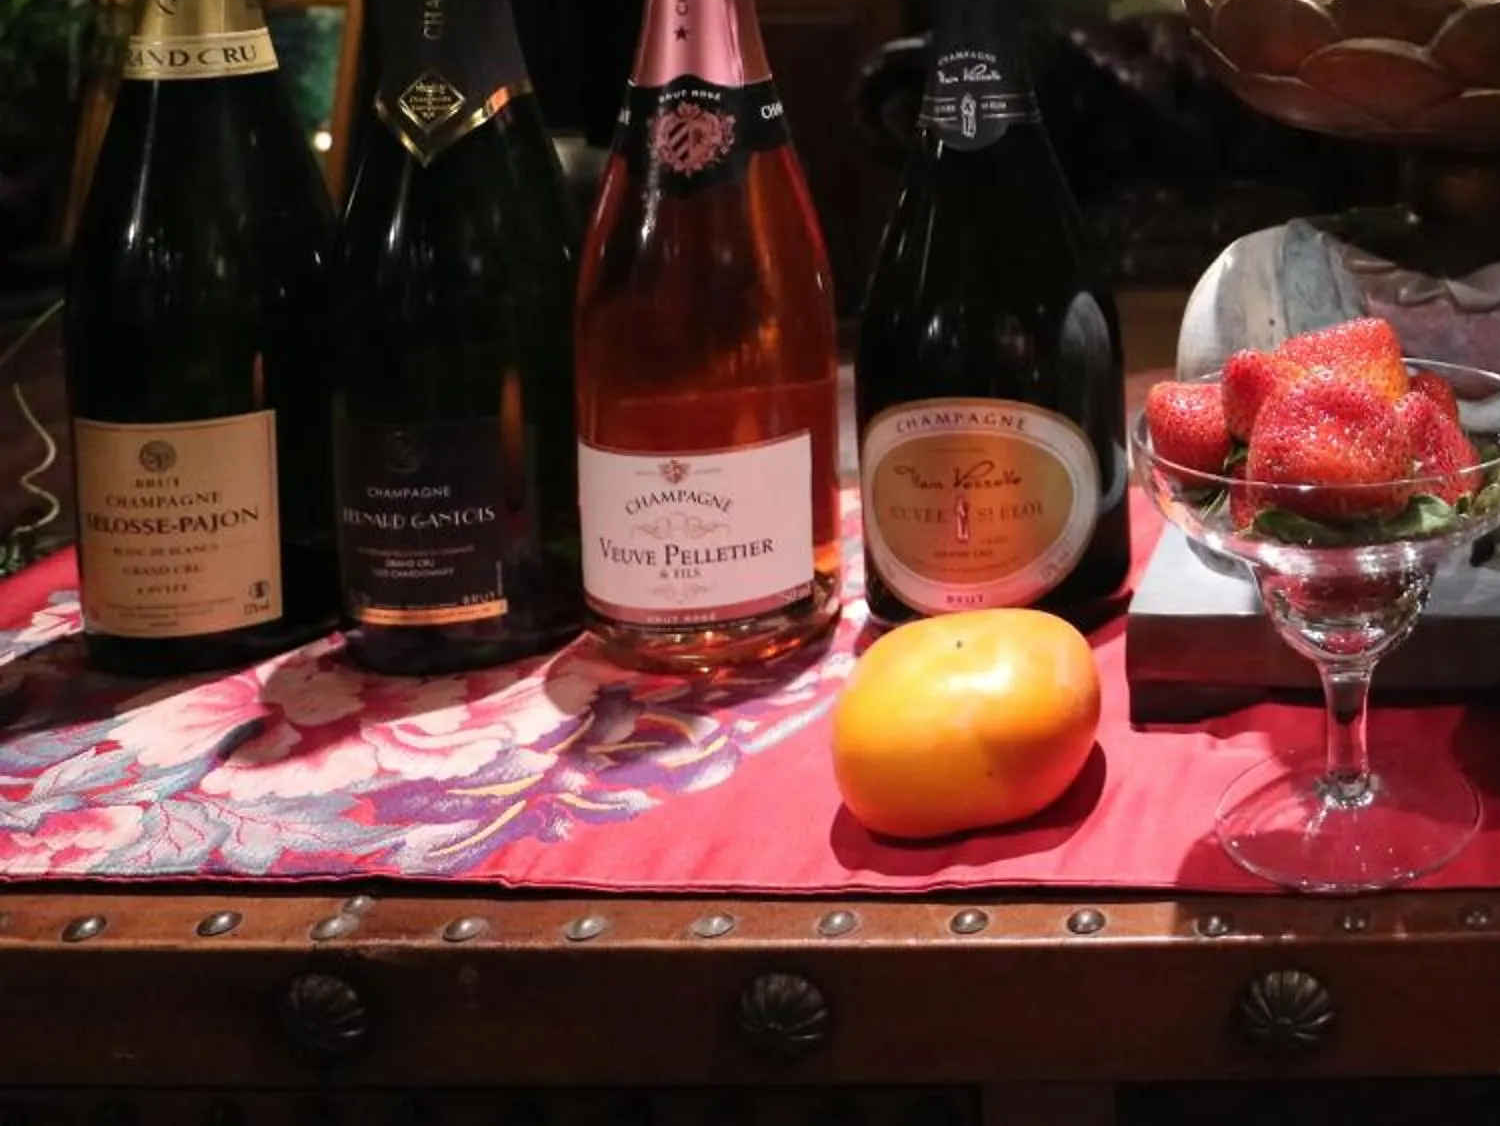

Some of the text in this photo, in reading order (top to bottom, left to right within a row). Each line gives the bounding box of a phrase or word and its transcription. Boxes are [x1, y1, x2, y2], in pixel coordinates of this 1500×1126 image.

[124, 44, 257, 68] RAND CRU
[895, 411, 1026, 433] CHAMPAGNE
[105, 490, 224, 509] CHAMPAGNE
[366, 484, 453, 500] CHAMPAGNE
[625, 488, 734, 516] CHAMPAGNE
[665, 538, 774, 566] PELLETIER
